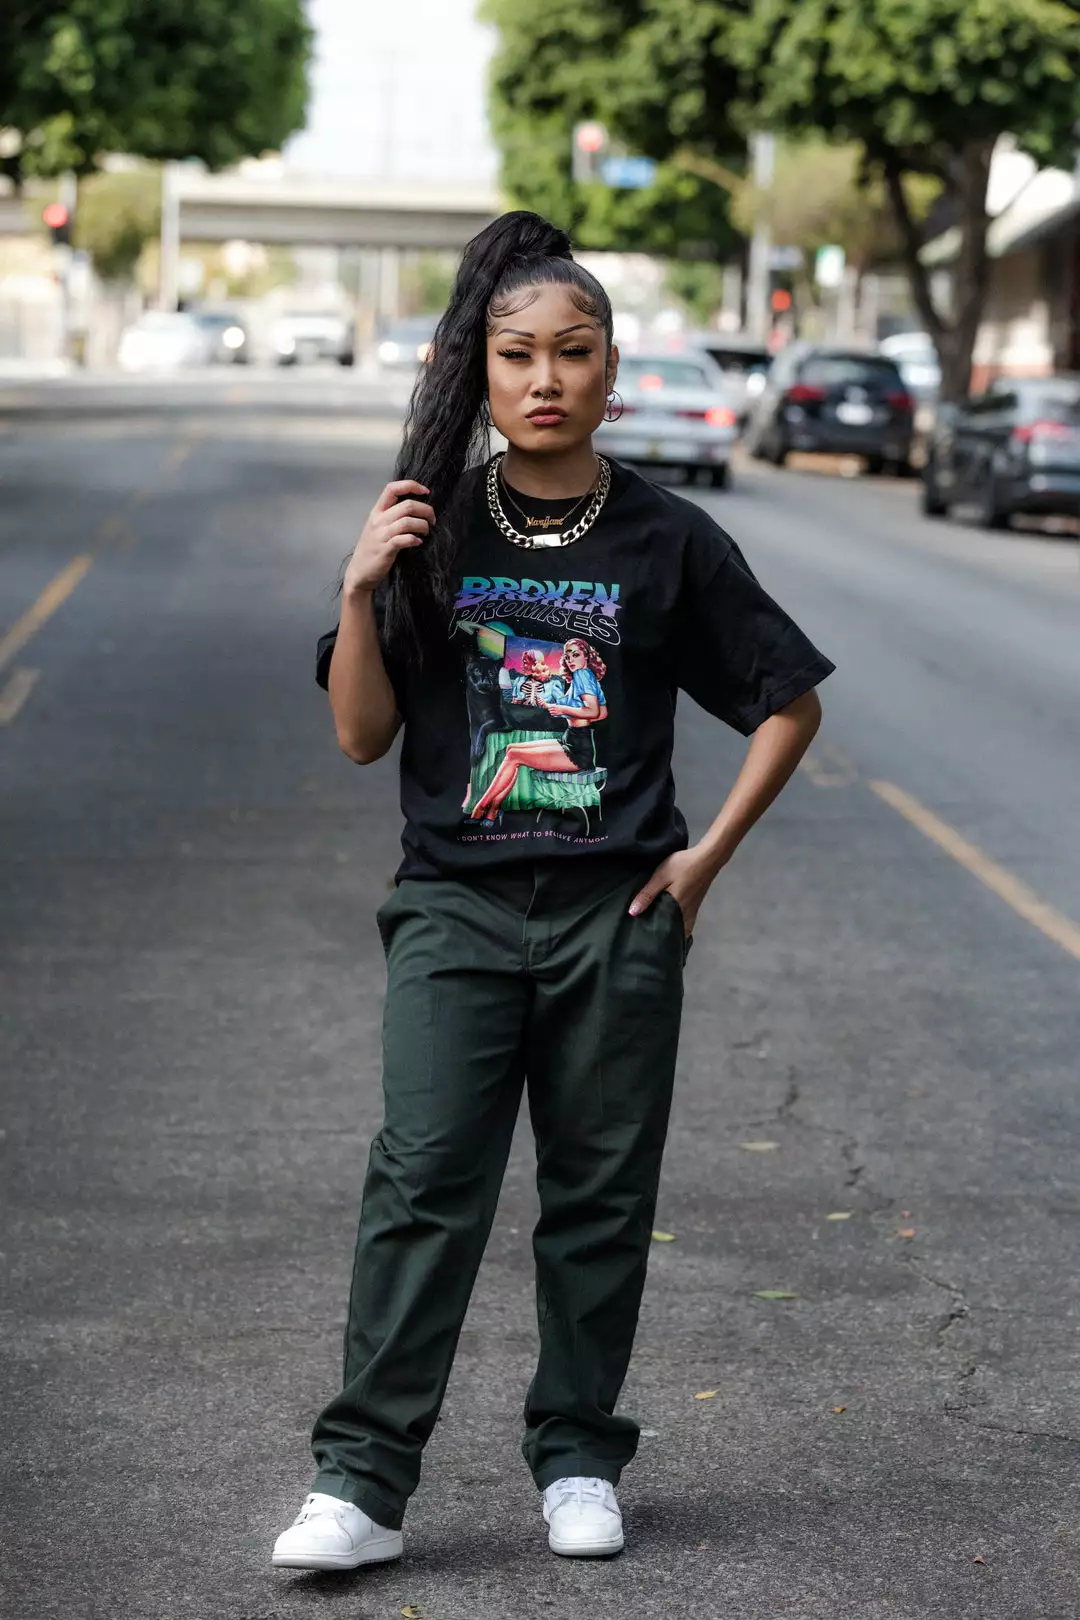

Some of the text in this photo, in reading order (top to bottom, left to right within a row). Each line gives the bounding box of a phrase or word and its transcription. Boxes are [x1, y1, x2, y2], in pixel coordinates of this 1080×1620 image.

[454, 576, 623, 617] BROKEN
[448, 599, 621, 646] PROMISES
[510, 831, 530, 840] WHAT
[545, 830, 571, 842] BELIEVE
